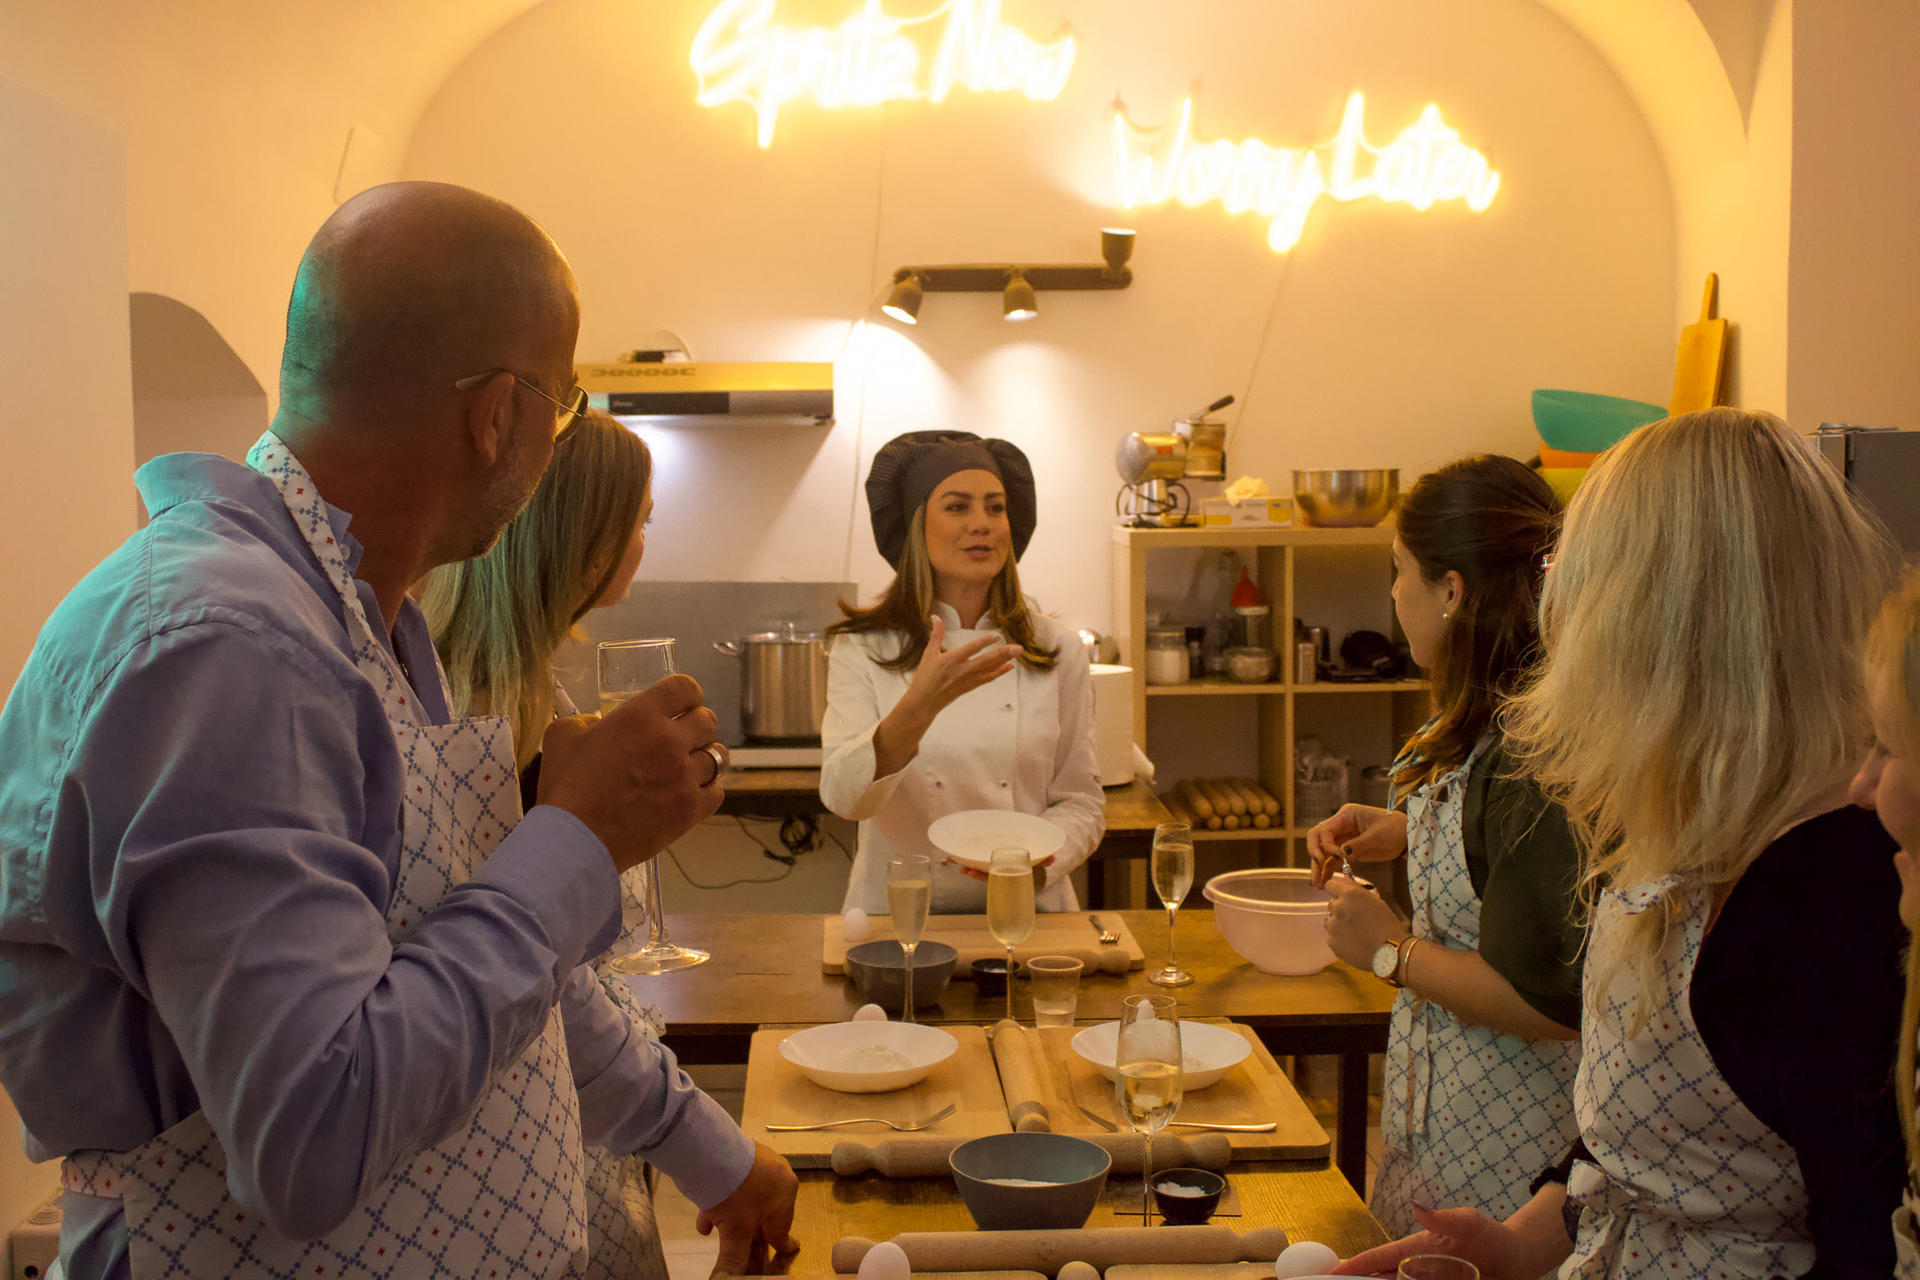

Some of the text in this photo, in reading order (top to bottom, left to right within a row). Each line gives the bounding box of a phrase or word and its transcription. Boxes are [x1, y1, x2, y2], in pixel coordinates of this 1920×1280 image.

[690, 0, 1076, 148] Spritz Now
[1113, 92, 1499, 252] Worry Later
